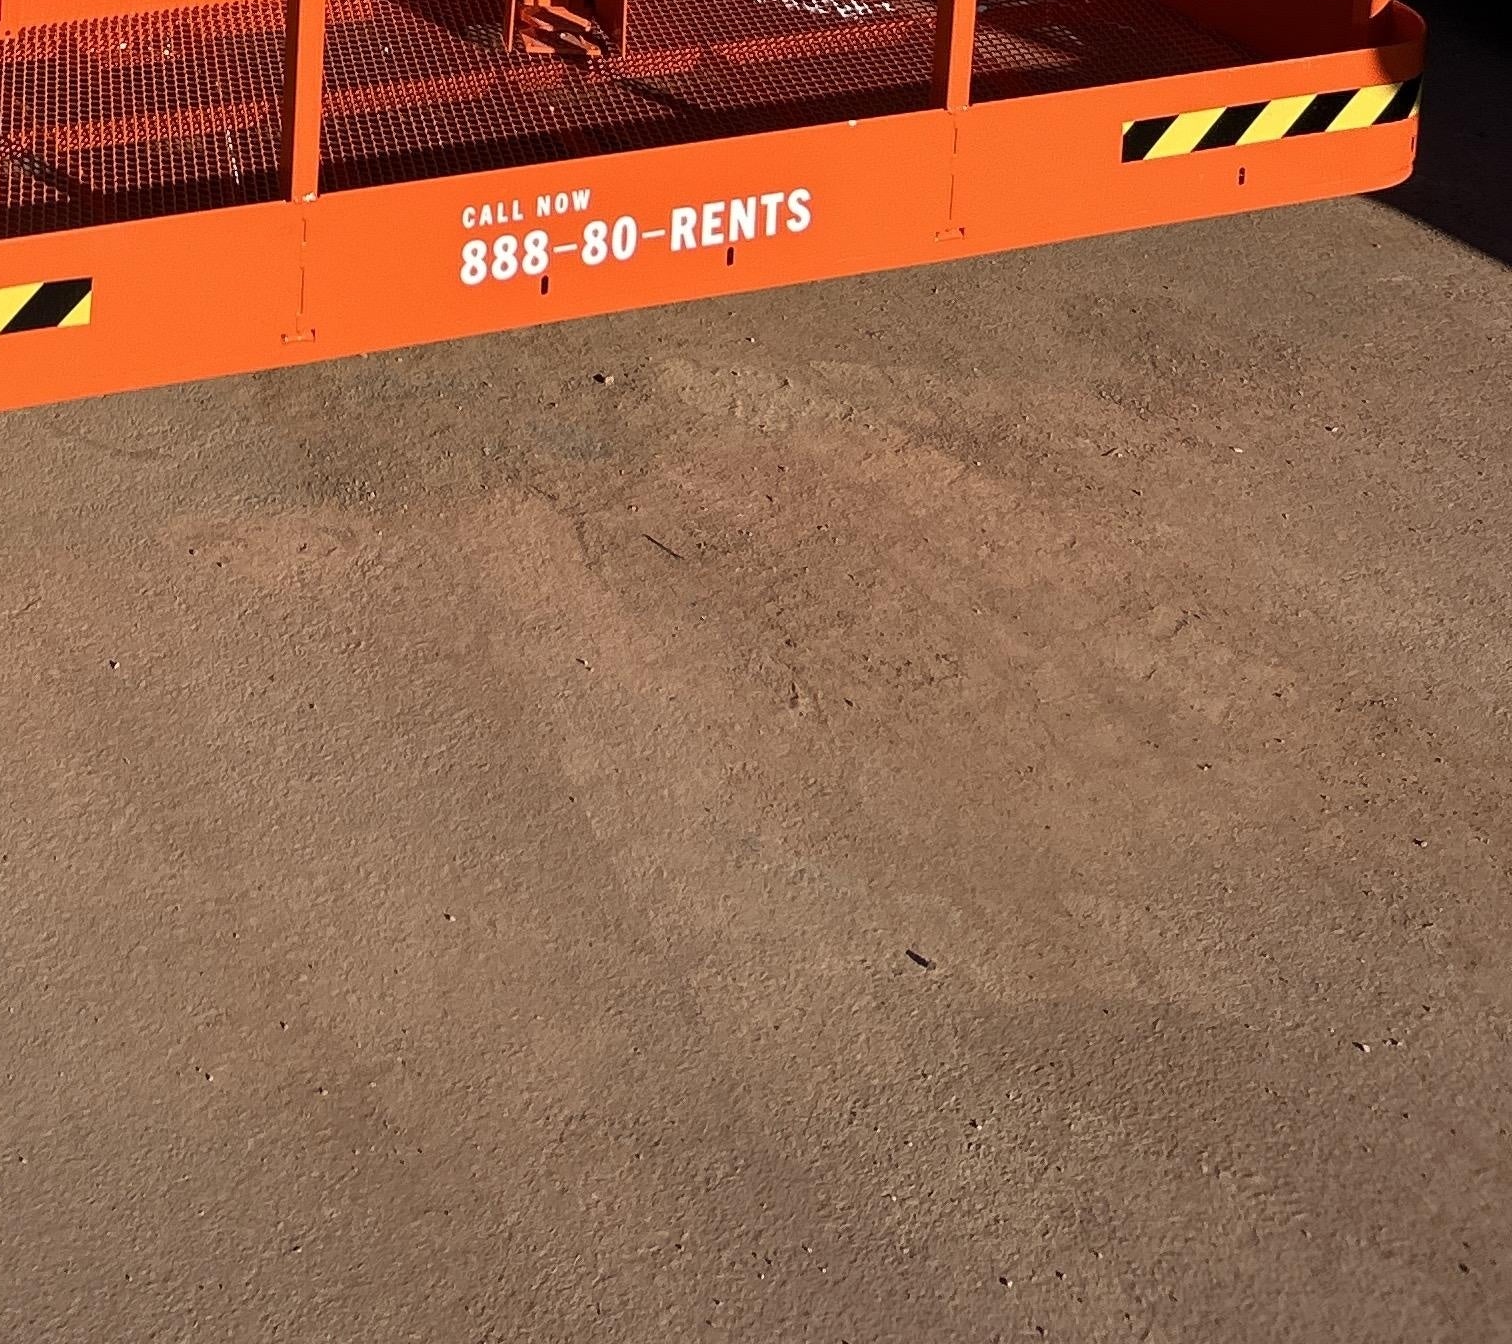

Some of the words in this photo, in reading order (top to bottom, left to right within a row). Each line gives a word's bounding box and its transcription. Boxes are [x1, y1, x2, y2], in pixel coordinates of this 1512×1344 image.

[458, 186, 813, 287] 888-80-RENTS
[461, 199, 525, 229] CALL
[536, 188, 592, 218] NOW
